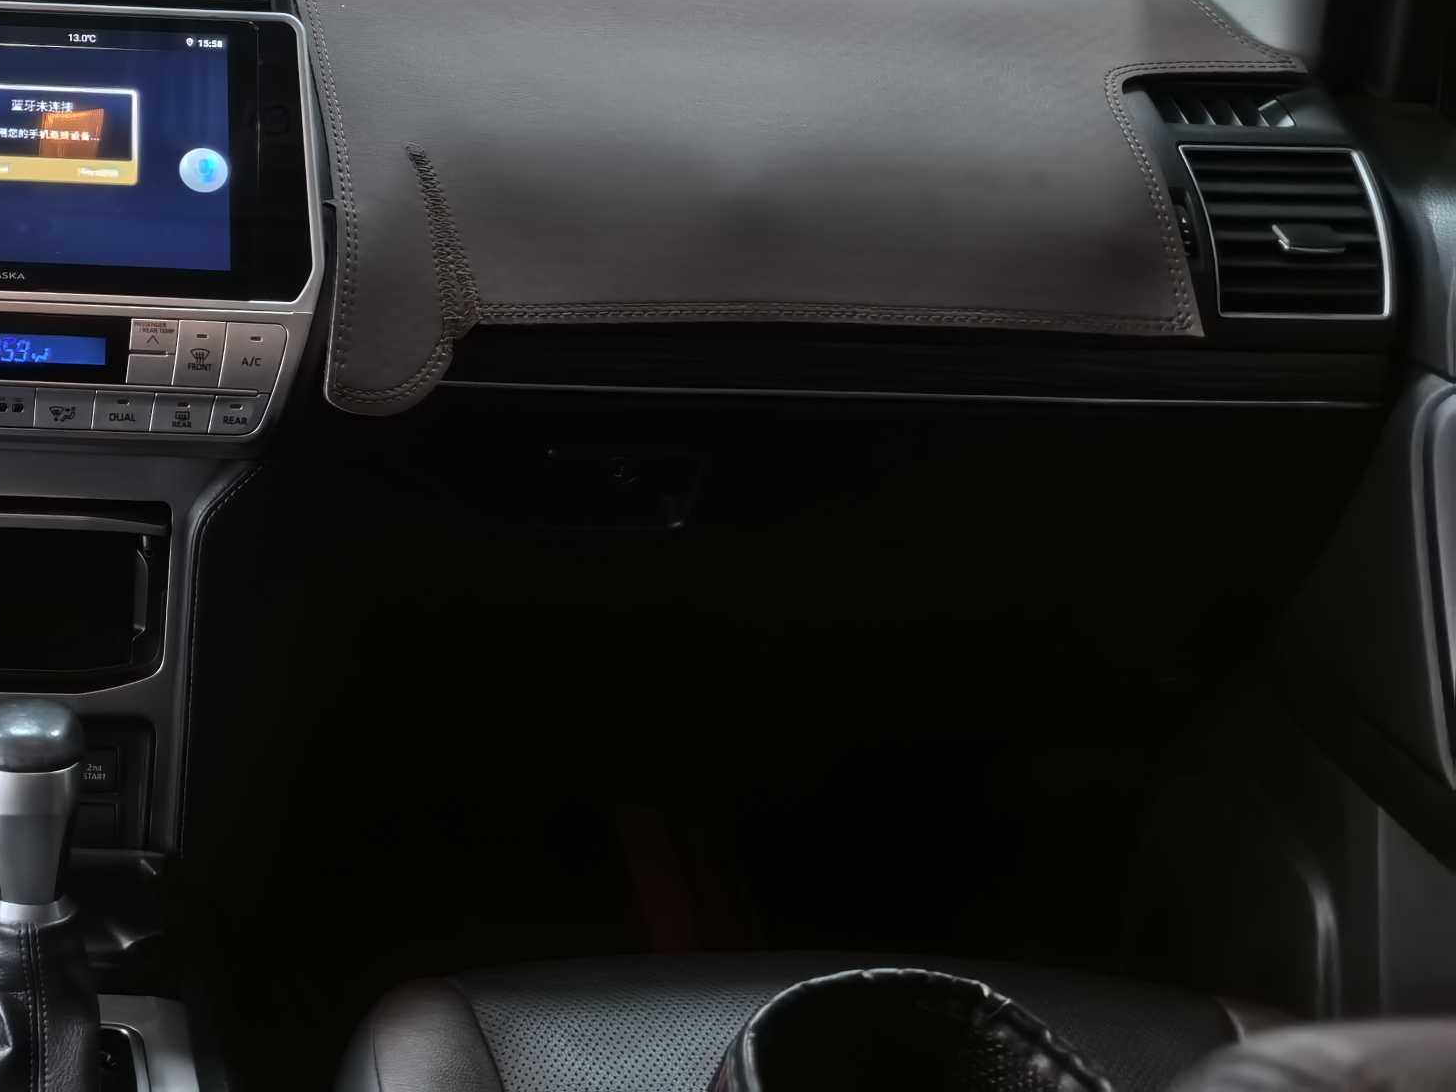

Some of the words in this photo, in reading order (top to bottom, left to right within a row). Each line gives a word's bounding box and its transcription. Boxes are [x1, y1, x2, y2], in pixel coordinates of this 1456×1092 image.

[11, 98, 74, 114] 蓝牙未连接
[241, 356, 262, 367] A/C
[187, 362, 213, 372] FRONT
[109, 412, 137, 423] DUAL
[223, 415, 248, 425] REAR
[172, 420, 192, 429] REAR
[83, 772, 106, 781] START
